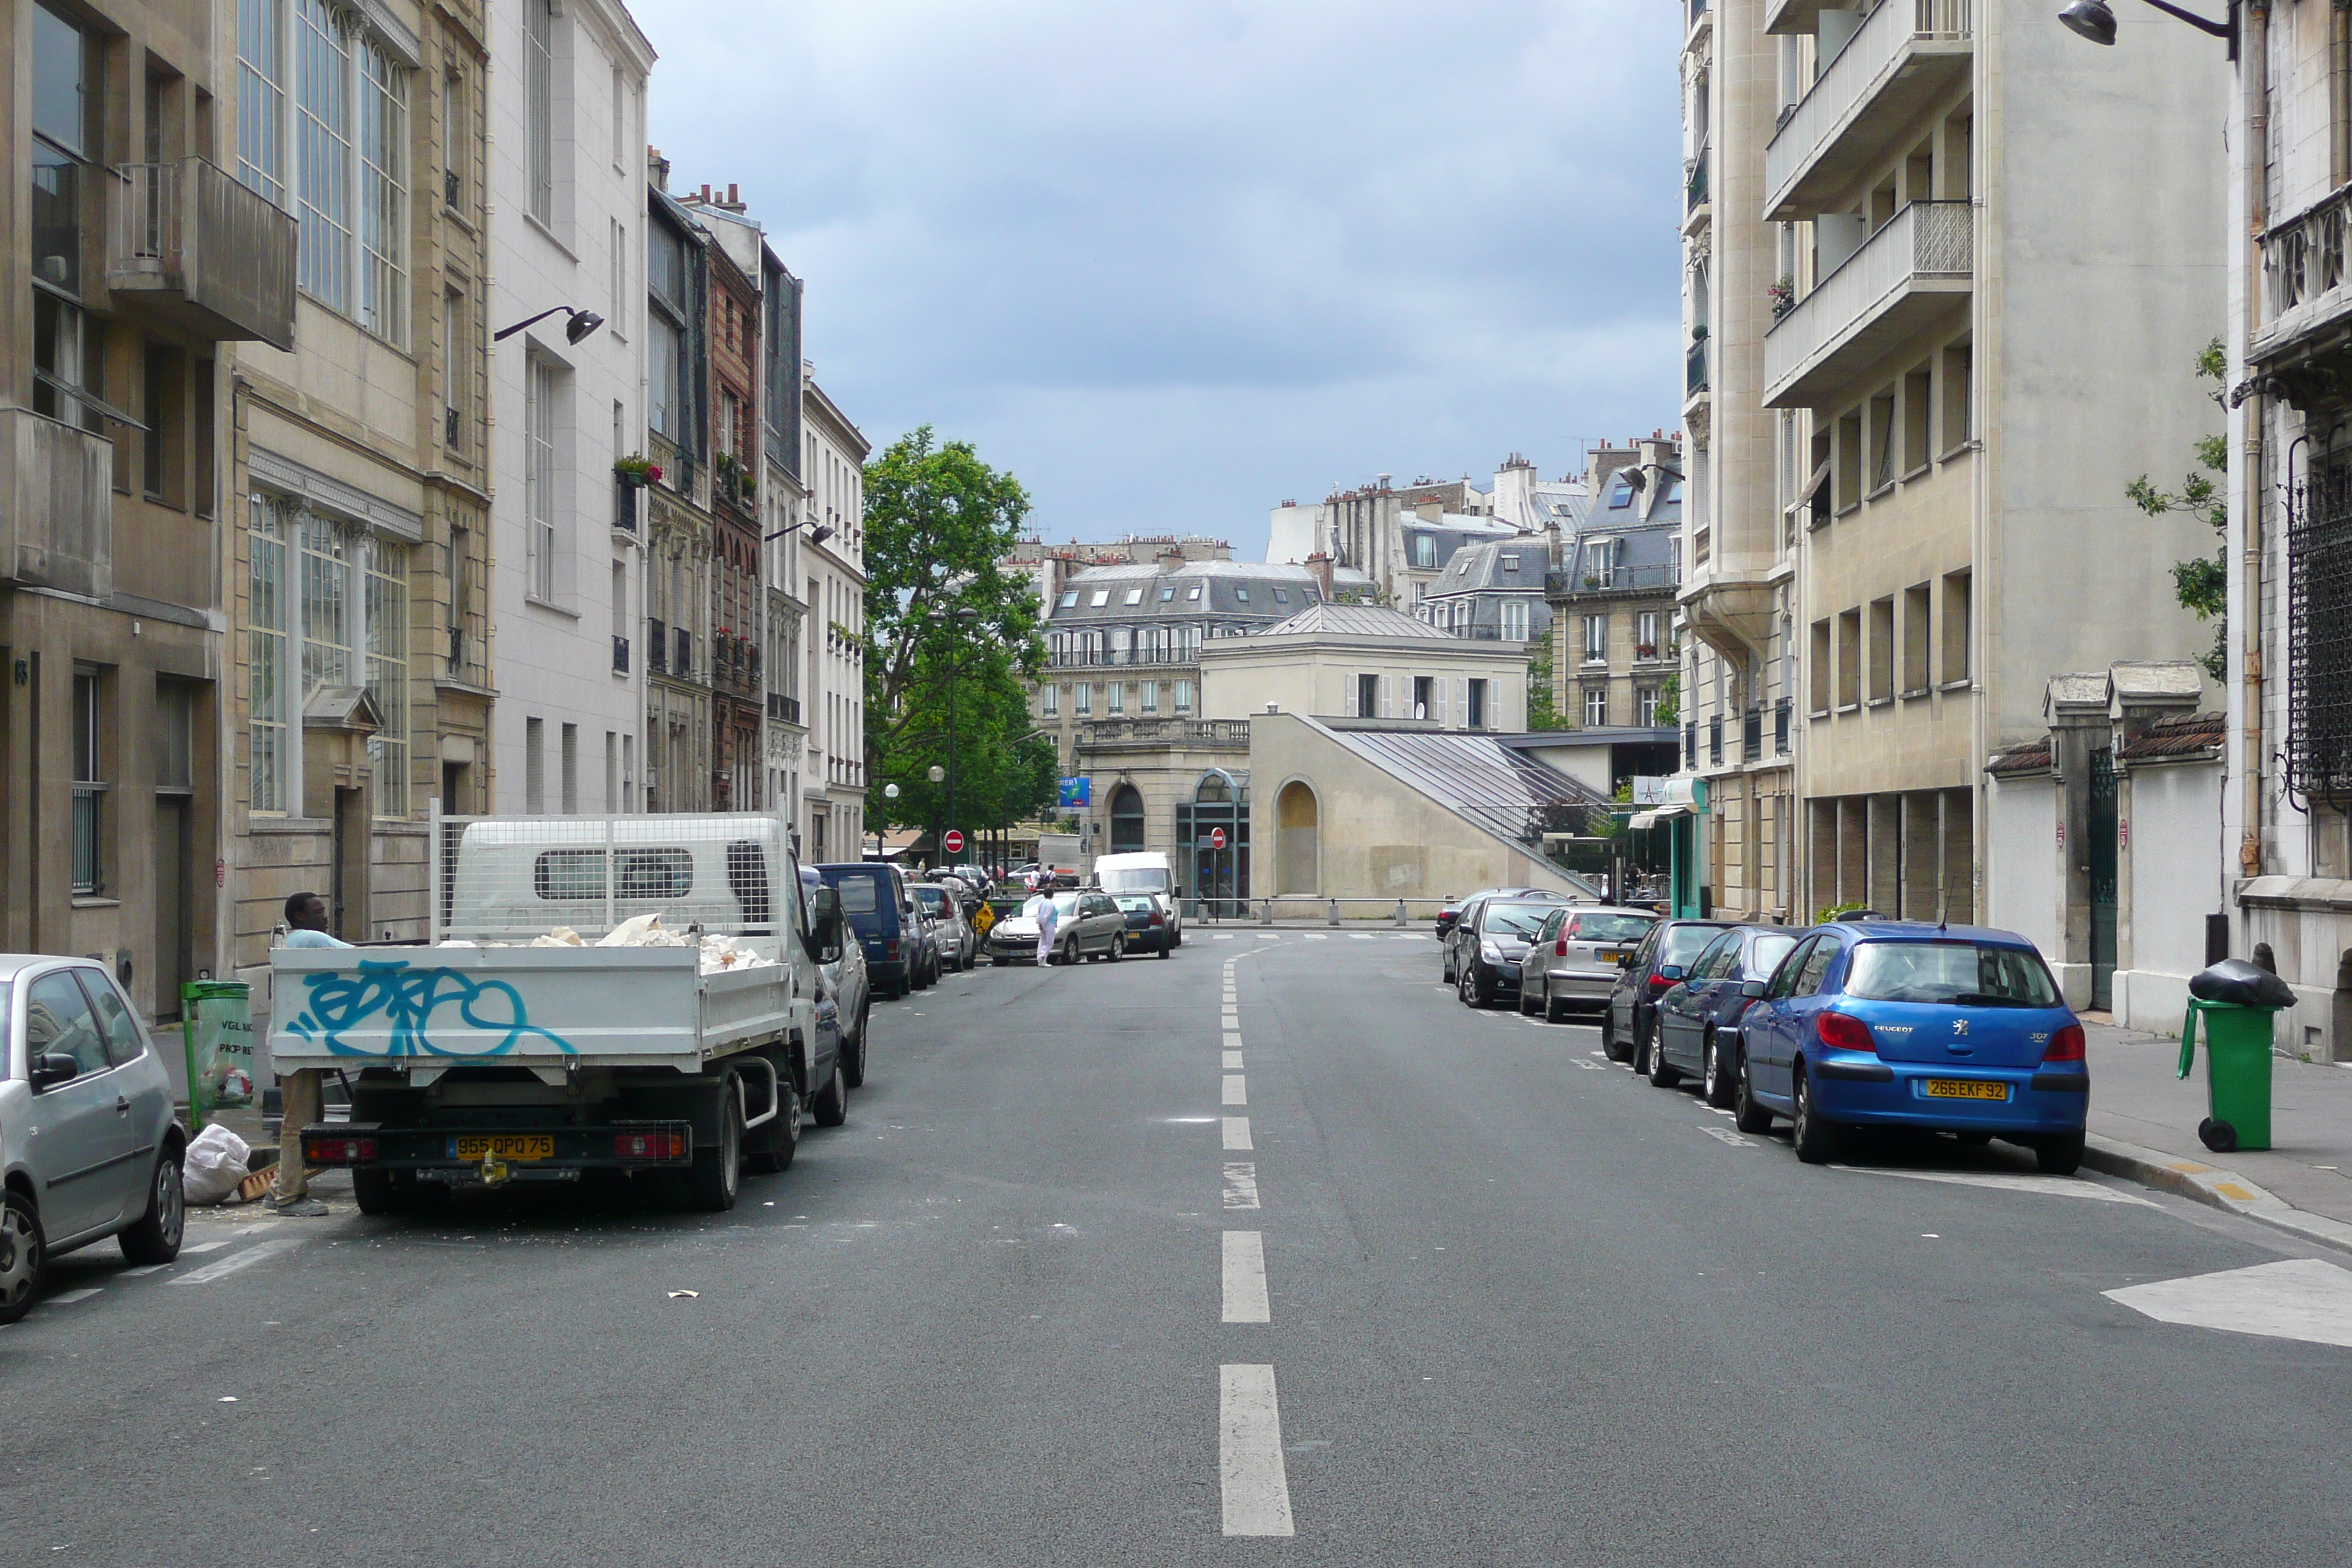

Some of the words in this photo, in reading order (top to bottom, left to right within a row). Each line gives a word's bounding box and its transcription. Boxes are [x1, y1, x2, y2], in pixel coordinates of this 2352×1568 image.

[1931, 1081, 1957, 1096] 266
[1959, 1082, 1984, 1096] EKF
[1986, 1084, 2003, 1098] 92
[457, 1138, 489, 1154] 955
[494, 1138, 525, 1154] QPQ
[529, 1137, 551, 1153] 75
